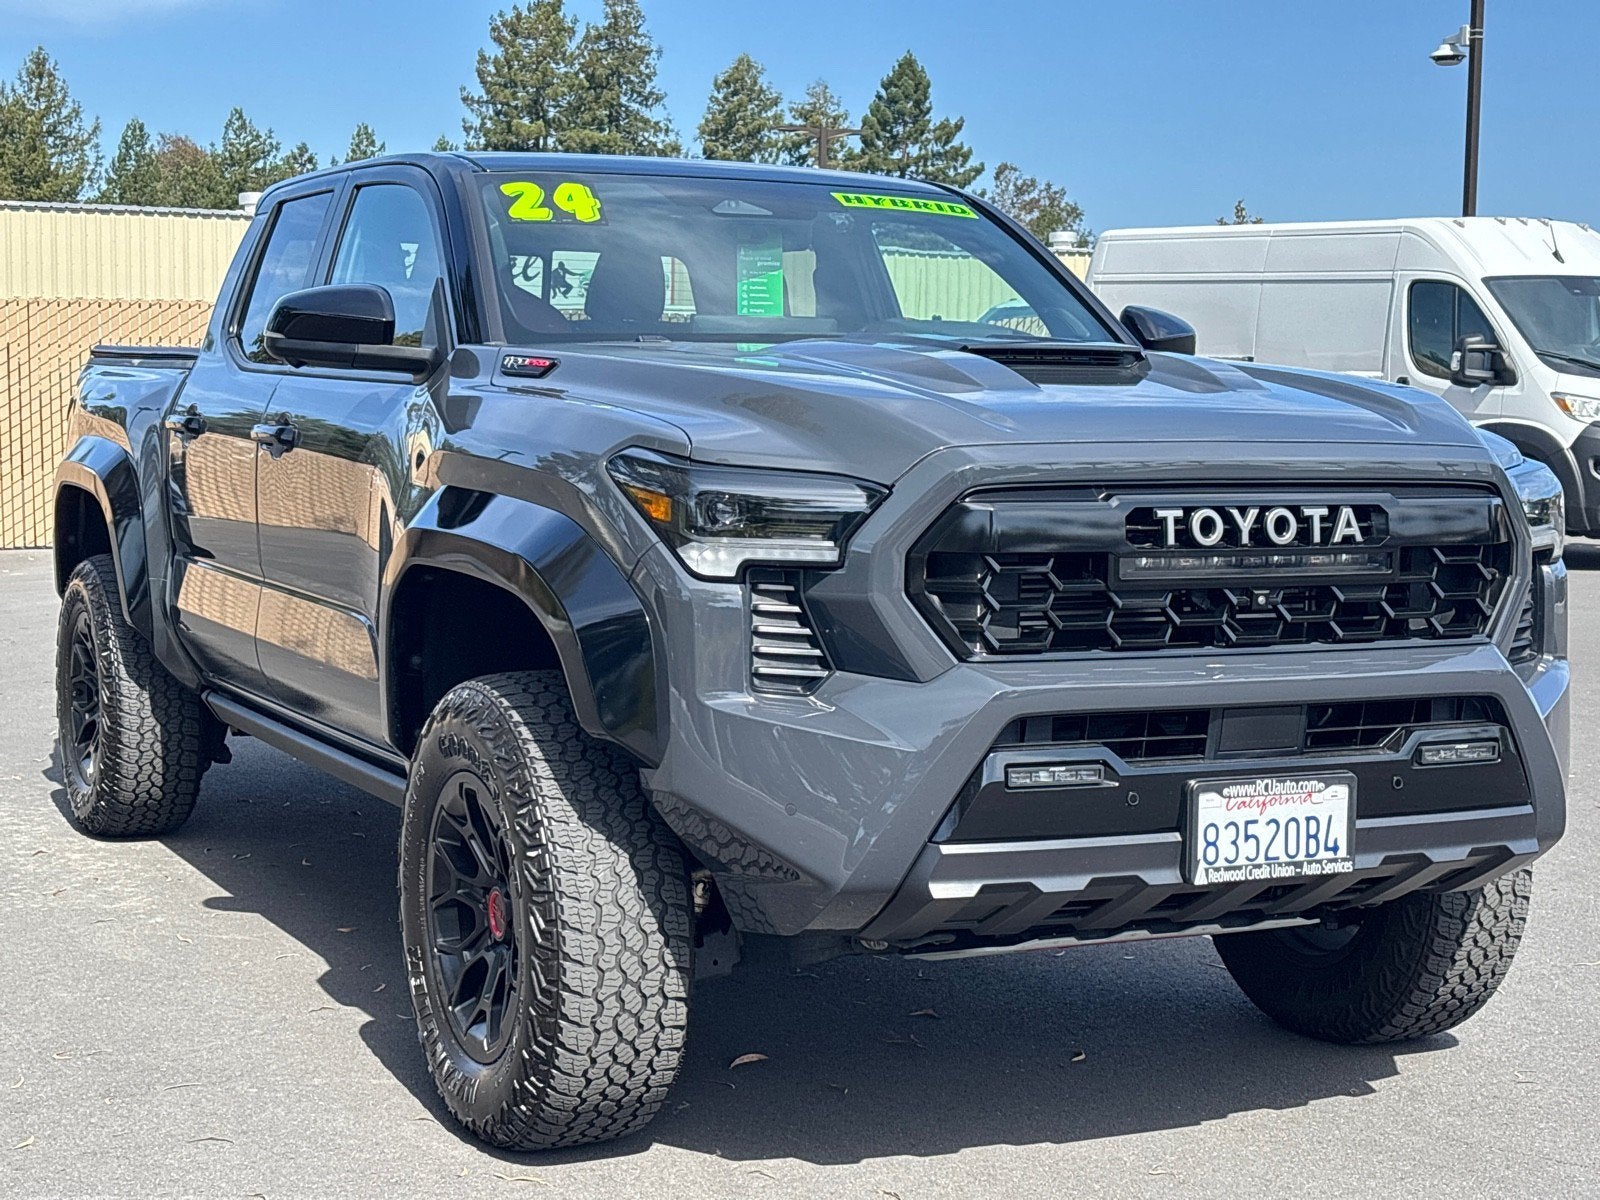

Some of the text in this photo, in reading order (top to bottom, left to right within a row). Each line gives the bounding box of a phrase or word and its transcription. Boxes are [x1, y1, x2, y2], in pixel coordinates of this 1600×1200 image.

[500, 182, 601, 222] 24
[842, 195, 970, 215] HYBRID
[1154, 506, 1364, 547] TOYOTA
[1229, 780, 1319, 798] www.RCUauto.com
[1226, 792, 1324, 816] California
[1203, 814, 1340, 866] 83520B4
[1208, 867, 1246, 883] Redwood
[1246, 864, 1270, 880] Credit
[1271, 863, 1295, 878] Union
[1302, 861, 1322, 875] Auto
[1322, 859, 1353, 873] Services
